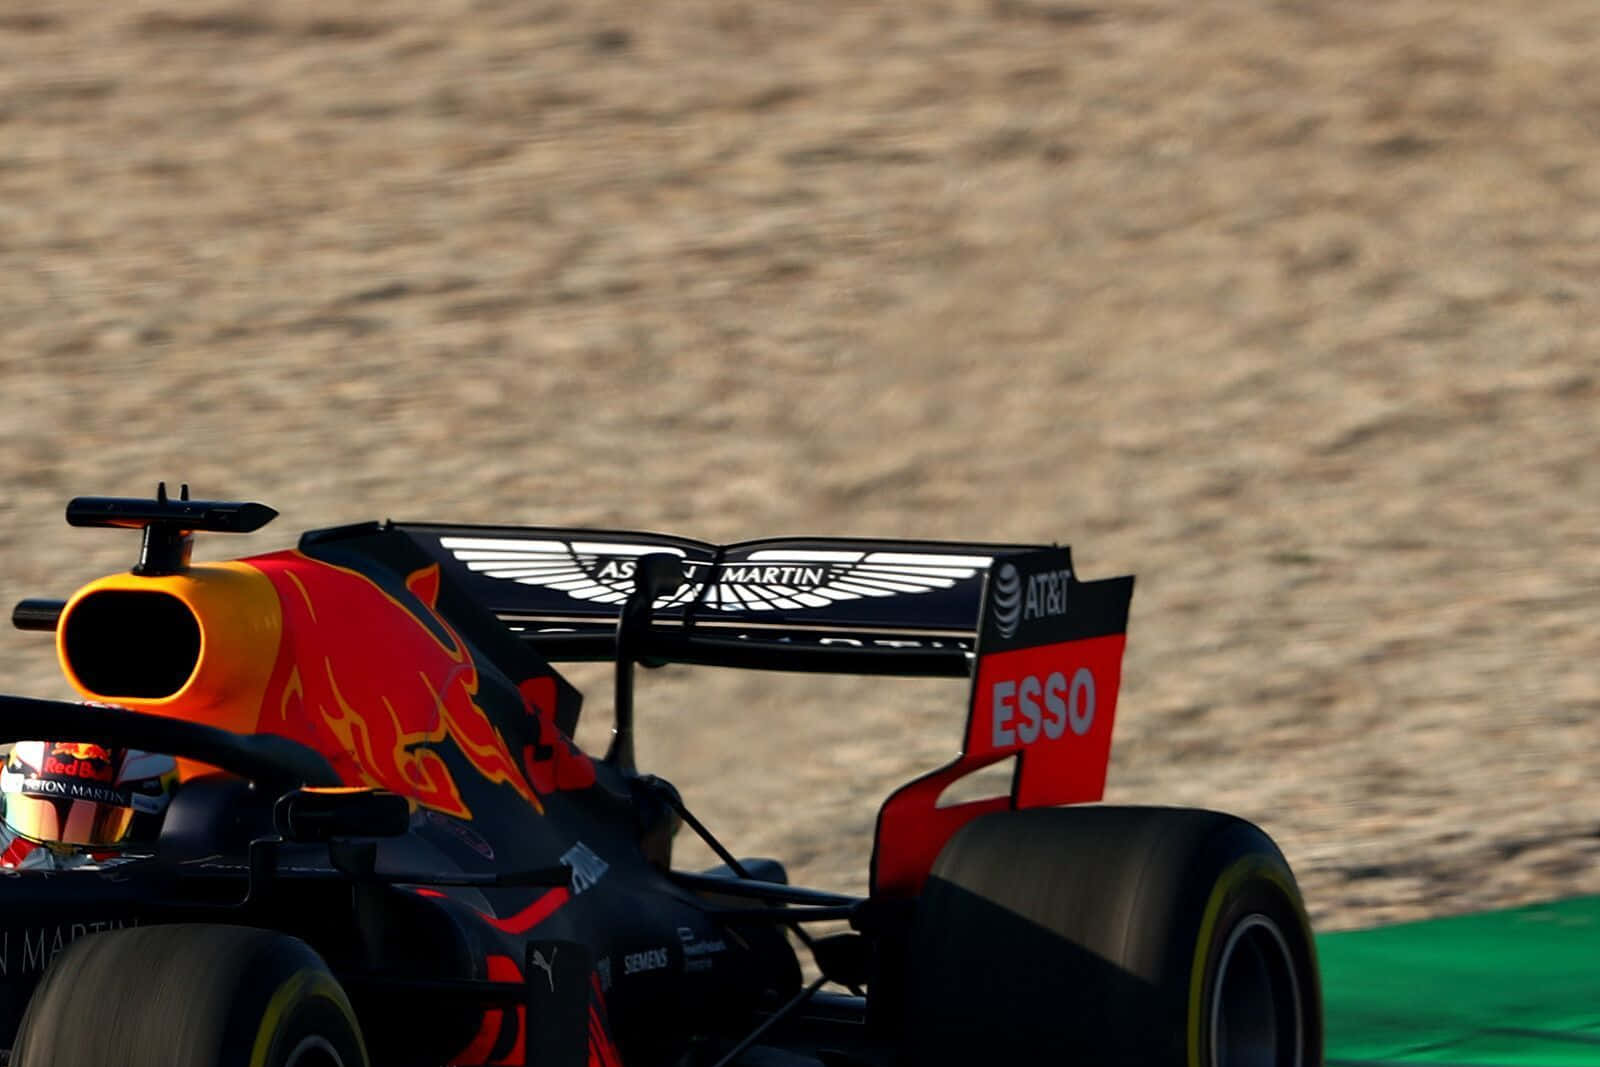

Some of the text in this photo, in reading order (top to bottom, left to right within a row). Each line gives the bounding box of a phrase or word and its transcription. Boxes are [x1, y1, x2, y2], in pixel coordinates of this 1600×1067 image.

[719, 564, 824, 586] MARTIN
[1023, 569, 1073, 621] AT&T
[991, 667, 1096, 748] ESSO
[44, 757, 78, 776] Red
[624, 949, 667, 974] SIEMENS
